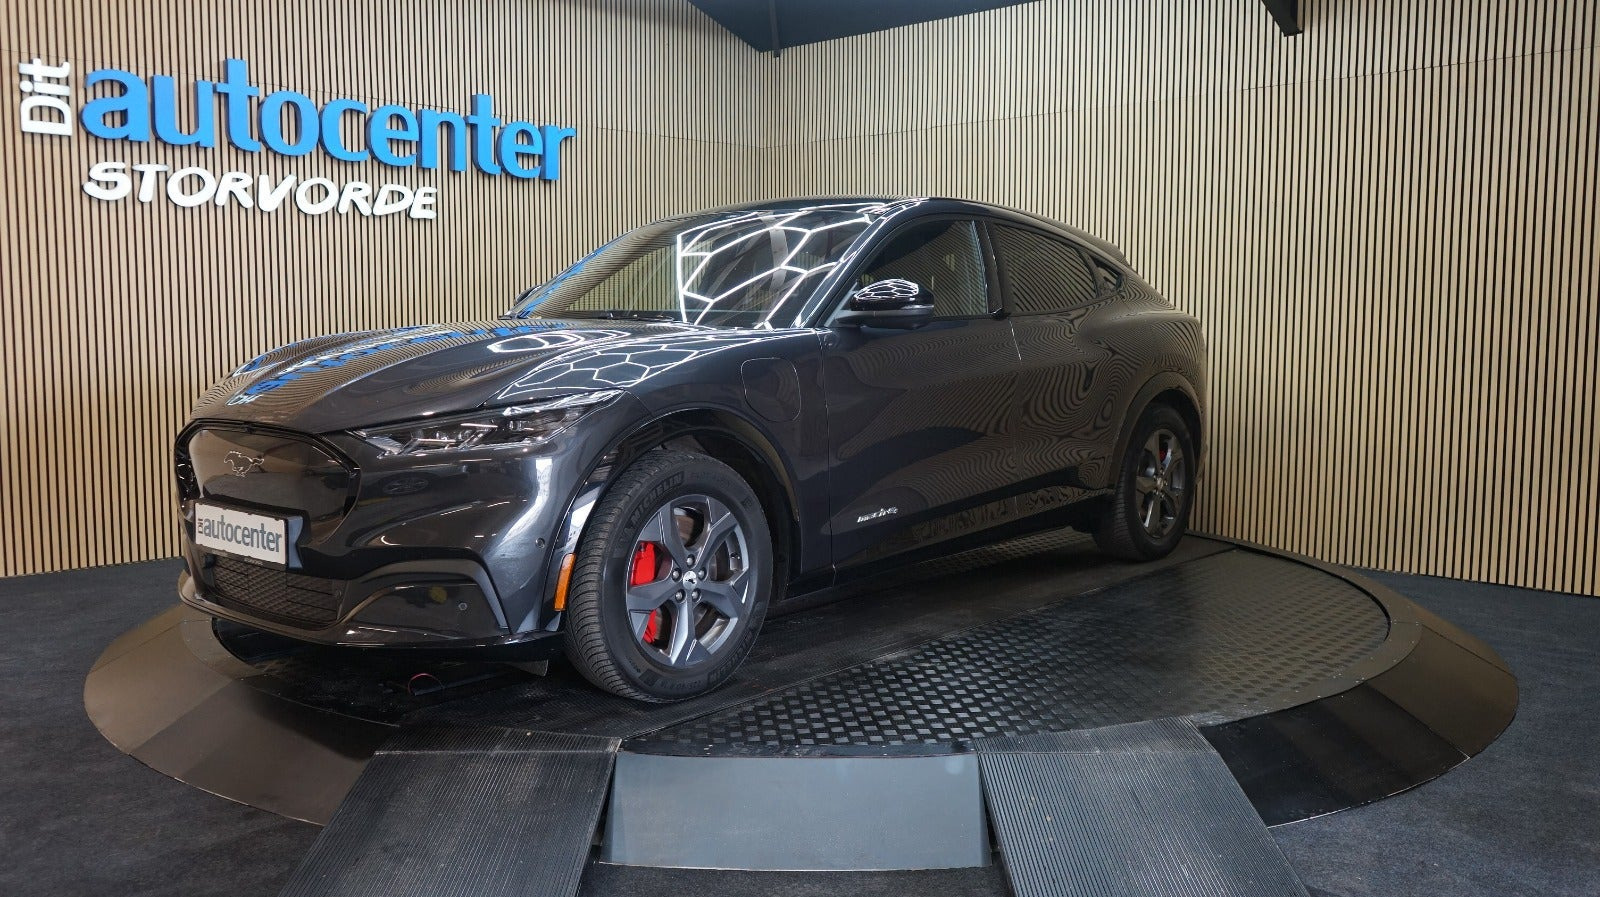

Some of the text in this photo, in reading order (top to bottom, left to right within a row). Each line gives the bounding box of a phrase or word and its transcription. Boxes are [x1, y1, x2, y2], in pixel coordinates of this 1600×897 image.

[19, 58, 576, 181] Dit autocenter
[83, 161, 438, 220] STORVORDE
[630, 472, 684, 527] MICHELIN
[204, 515, 282, 552] autocenter
